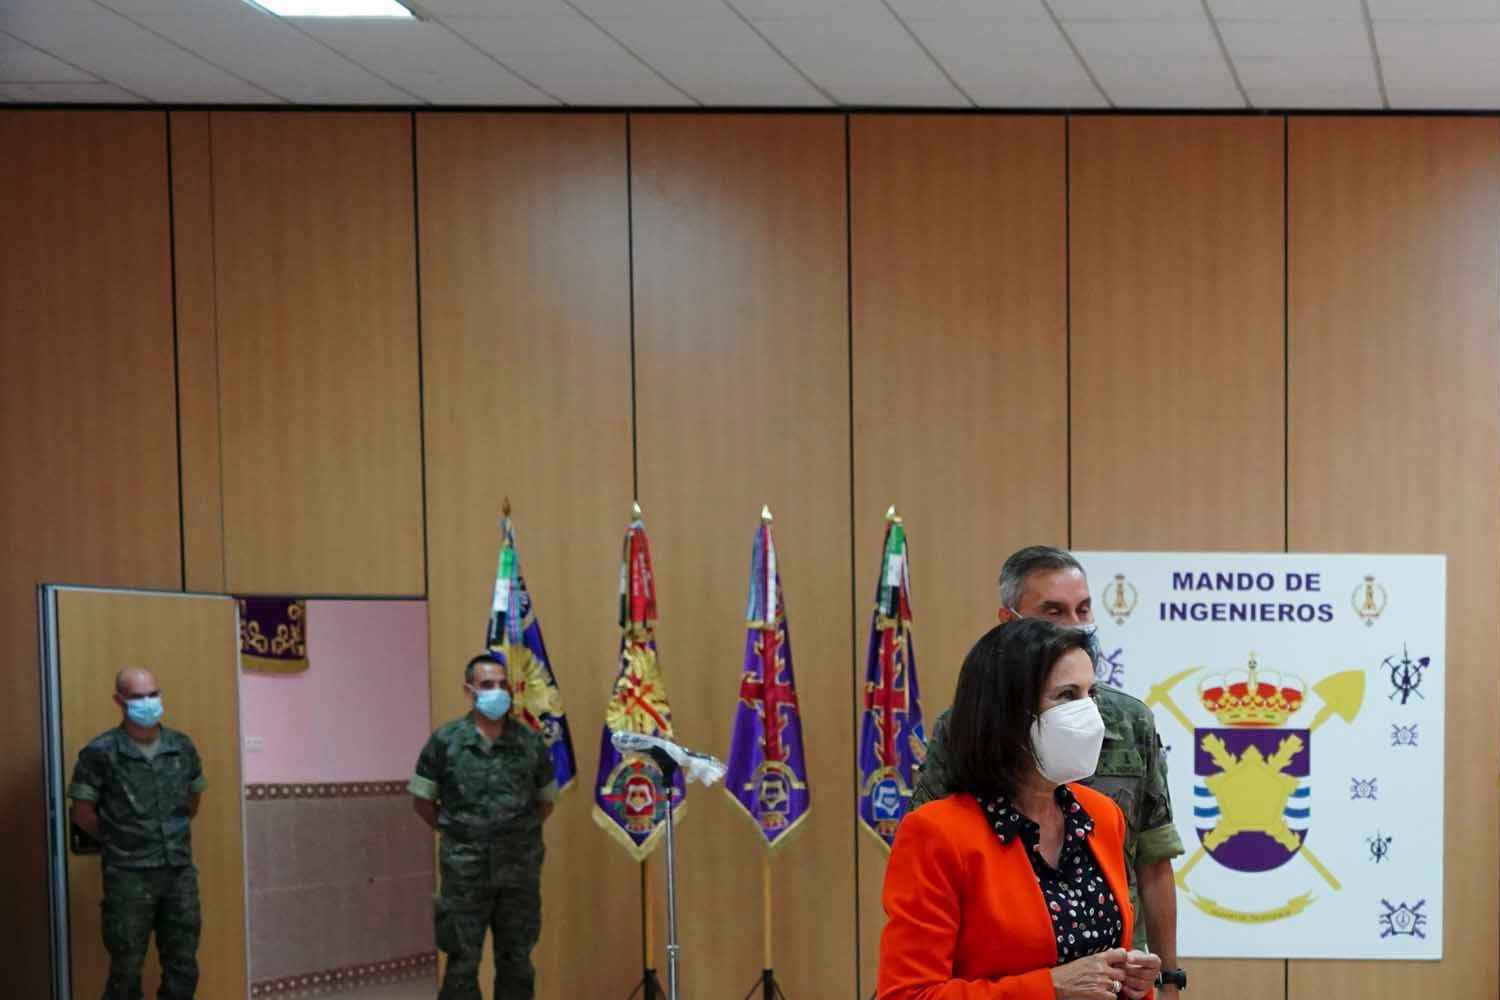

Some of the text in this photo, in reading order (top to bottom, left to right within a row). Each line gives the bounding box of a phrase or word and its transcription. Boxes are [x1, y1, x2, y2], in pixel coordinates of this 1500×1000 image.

[1172, 572, 1321, 591] MANDO DE
[1159, 602, 1334, 622] INGENIEROS
